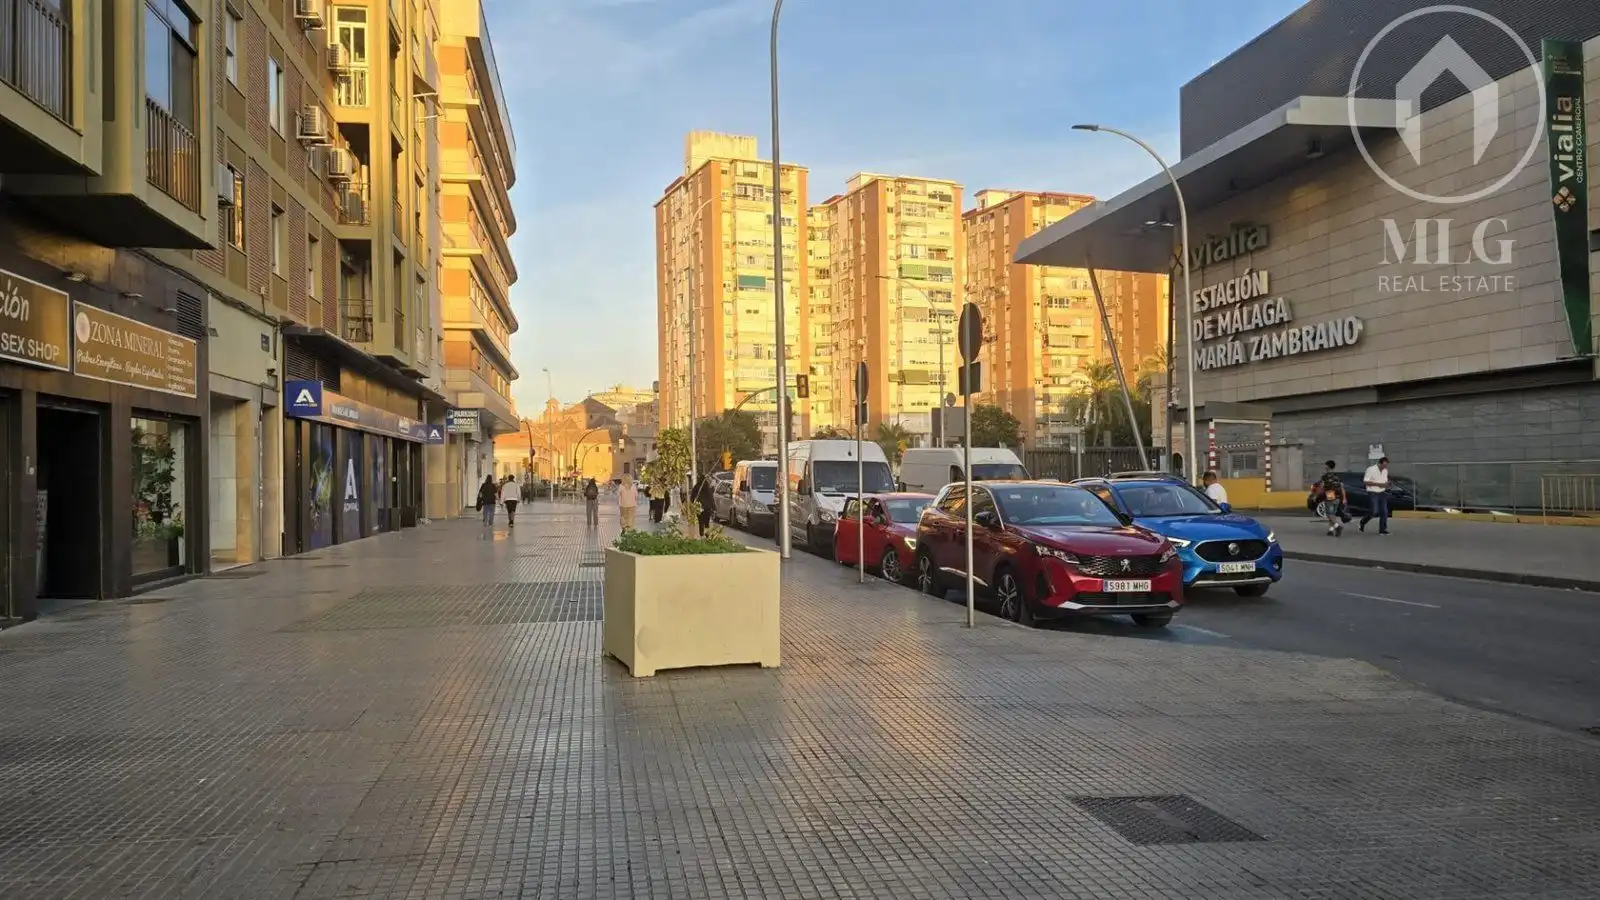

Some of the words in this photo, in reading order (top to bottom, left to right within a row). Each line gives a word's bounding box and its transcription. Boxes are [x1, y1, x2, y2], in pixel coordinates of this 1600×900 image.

[1552, 96, 1574, 182] vialia
[1574, 97, 1584, 146] COMERCIAL
[1575, 147, 1585, 184] CENTRO
[1193, 268, 1269, 314] ESTACIÓN
[91, 321, 123, 348] ZONA
[123, 330, 165, 359] MINERAL
[1193, 315, 1213, 343] DE
[1217, 296, 1293, 337] MÁLAGA
[1, 332, 25, 355] SEX
[27, 338, 61, 361] SHOP
[1193, 335, 1248, 372] MARÍA
[1249, 315, 1364, 362] ZAMBRANO
[1109, 581, 1130, 591] 5981
[1133, 581, 1149, 591] MHG
